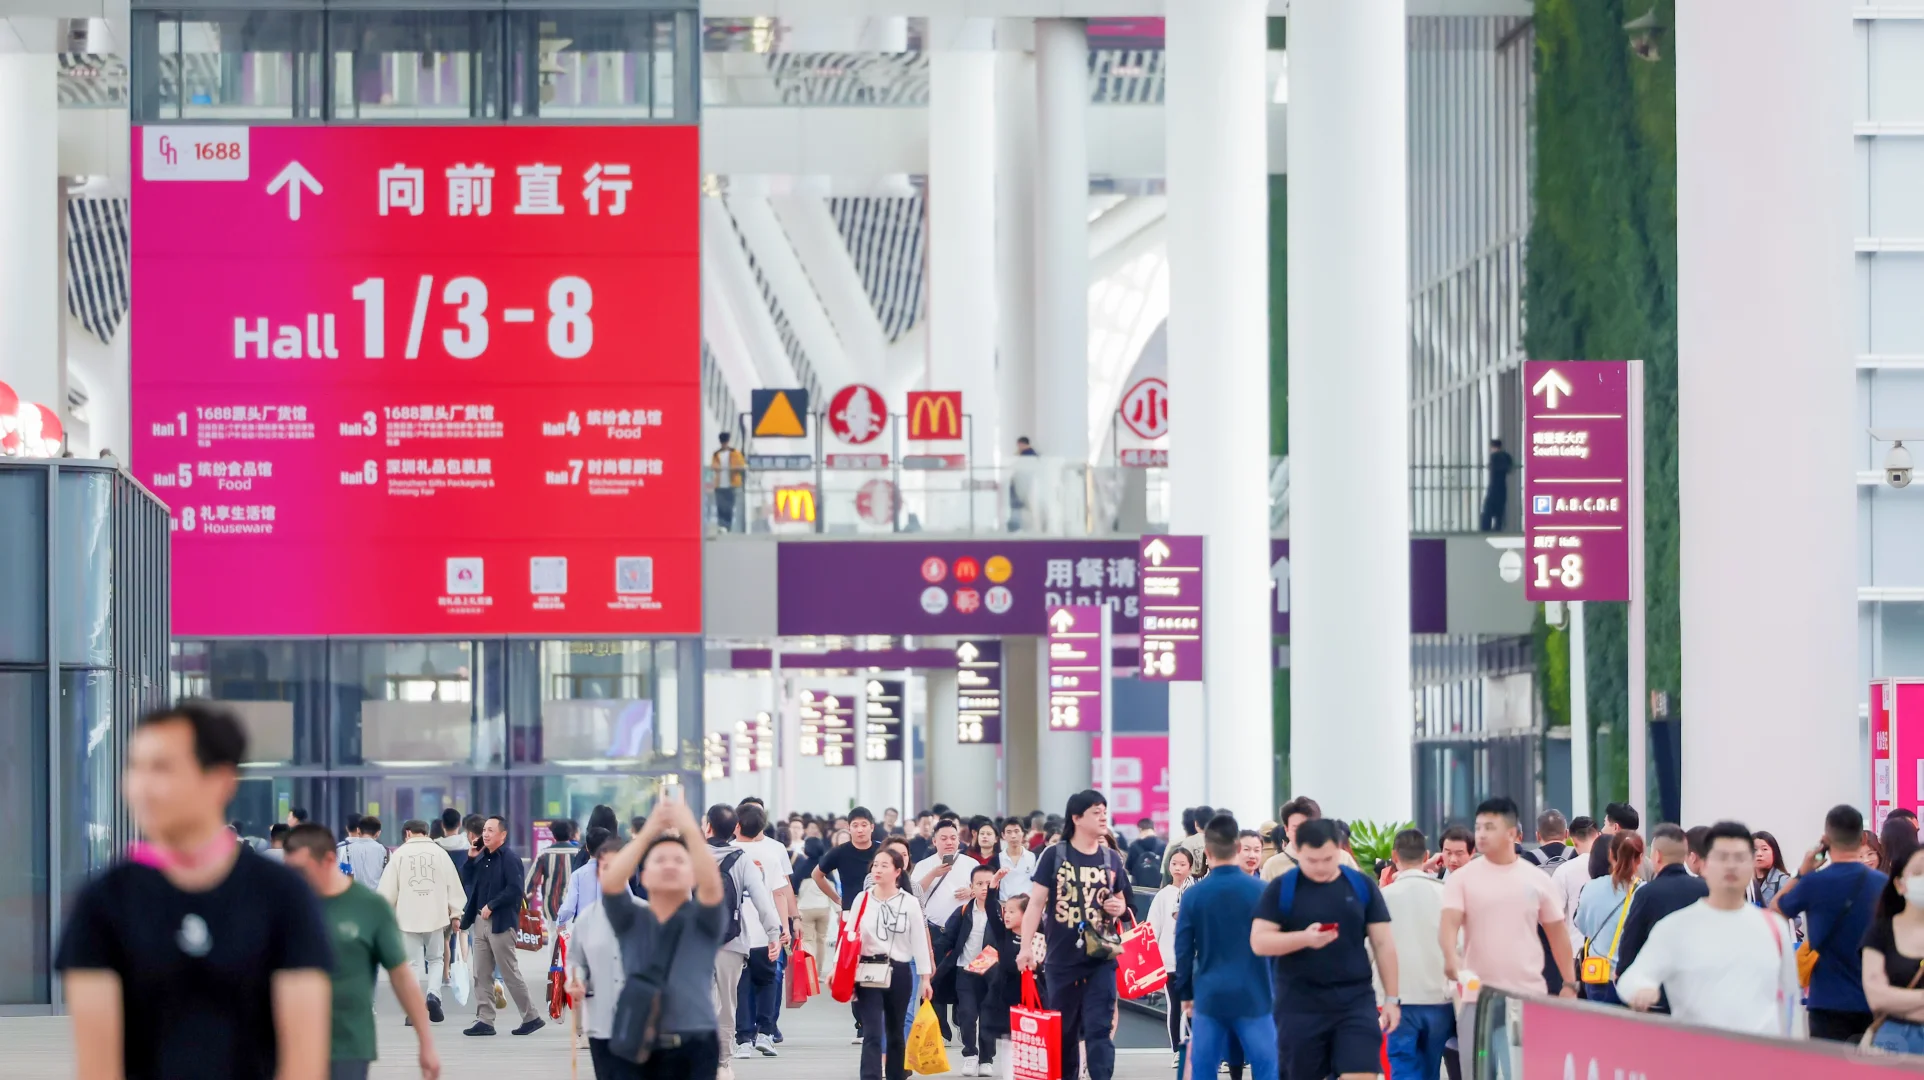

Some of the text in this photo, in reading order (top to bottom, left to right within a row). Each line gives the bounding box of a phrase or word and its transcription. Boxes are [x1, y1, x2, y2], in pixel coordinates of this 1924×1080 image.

[194, 142, 241, 160] 1688
[377, 162, 633, 217] 向前直行
[233, 274, 595, 360] Hall 1/3-8
[152, 422, 175, 437] Hall
[177, 411, 188, 436] 1
[339, 422, 362, 437] Hall
[363, 411, 377, 437] 3
[542, 410, 581, 437] Hall 4
[607, 426, 642, 439] Food
[1533, 445, 1588, 459] South Lobby
[153, 463, 193, 488] Hall 5
[218, 477, 252, 491] Food
[340, 459, 378, 485] Hall 6
[545, 459, 584, 485] Hall 7
[182, 506, 196, 532] 8
[203, 522, 273, 534] Houseware
[1532, 553, 1584, 588] 1-8
[1143, 651, 1176, 677] 1-8
